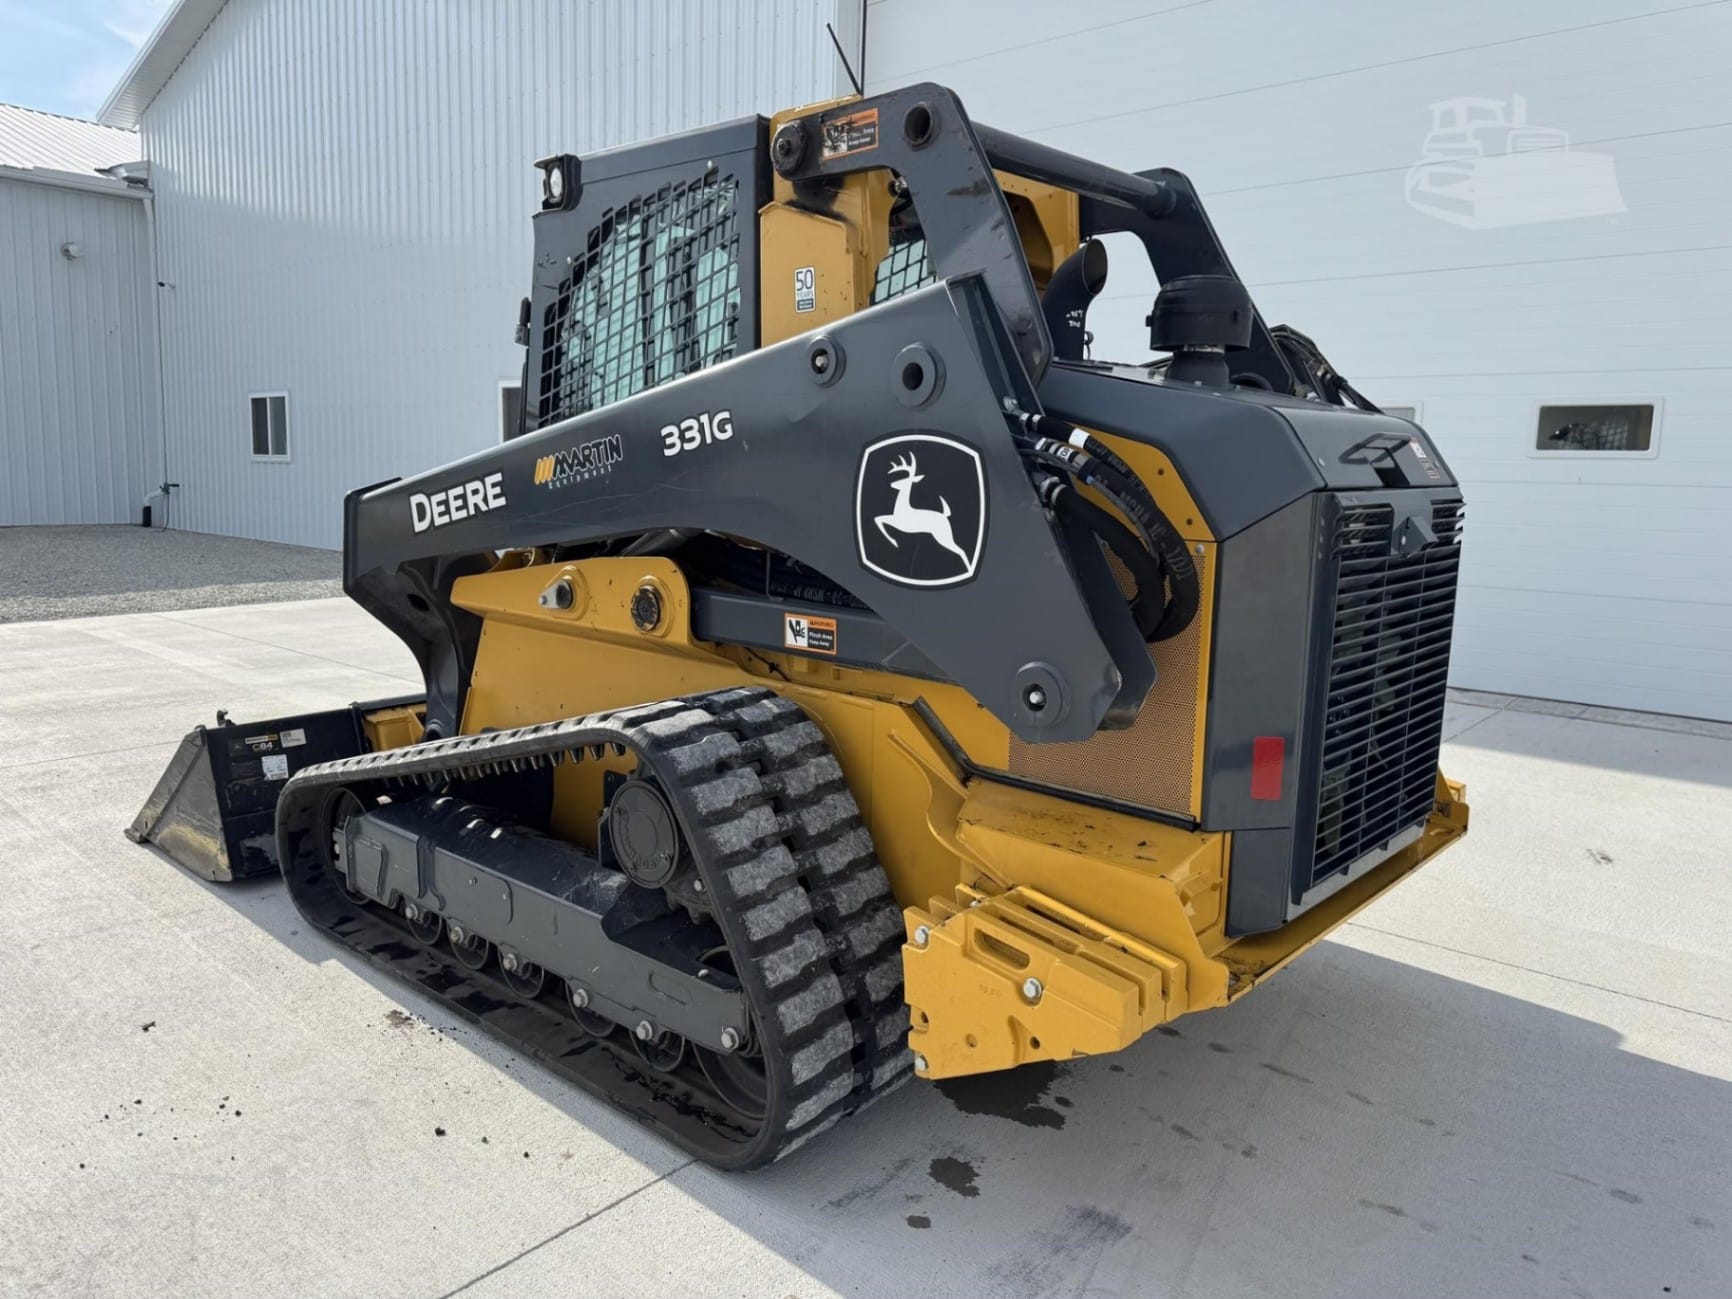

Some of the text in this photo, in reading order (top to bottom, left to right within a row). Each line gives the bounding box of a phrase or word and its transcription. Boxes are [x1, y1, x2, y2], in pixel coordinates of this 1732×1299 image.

[796, 269, 813, 291] 50
[552, 434, 623, 480] MARTIN
[661, 411, 733, 457] 331G
[409, 472, 506, 533] DEERE
